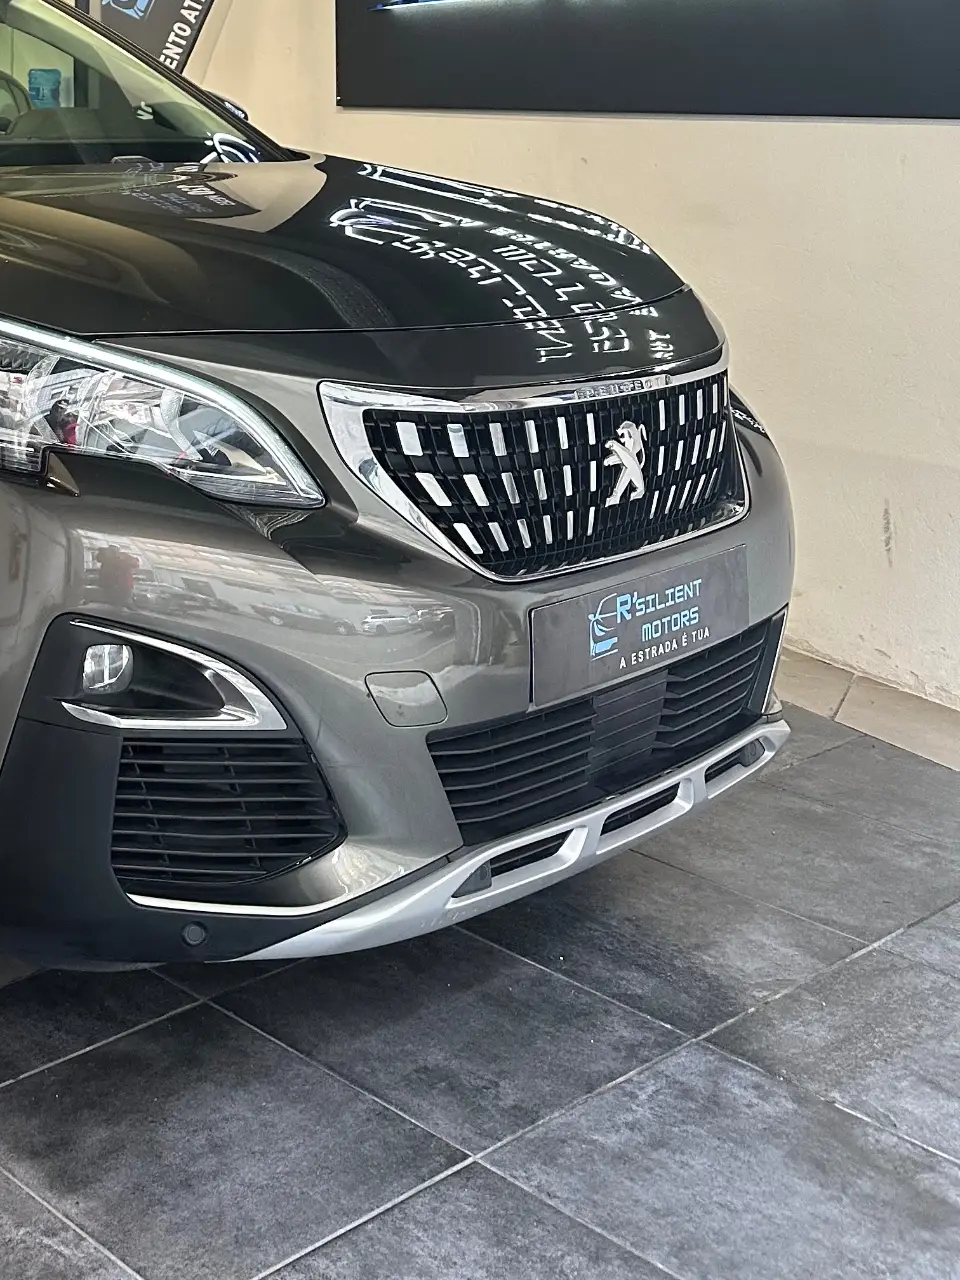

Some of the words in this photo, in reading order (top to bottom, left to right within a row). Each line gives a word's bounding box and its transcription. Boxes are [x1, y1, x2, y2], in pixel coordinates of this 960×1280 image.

[616, 578, 702, 624] R'SILIENT
[641, 606, 700, 642] MOTORS
[619, 656, 627, 669] A
[631, 638, 678, 666] ESTRADA
[681, 631, 689, 647] É
[691, 626, 710, 644] TUA
